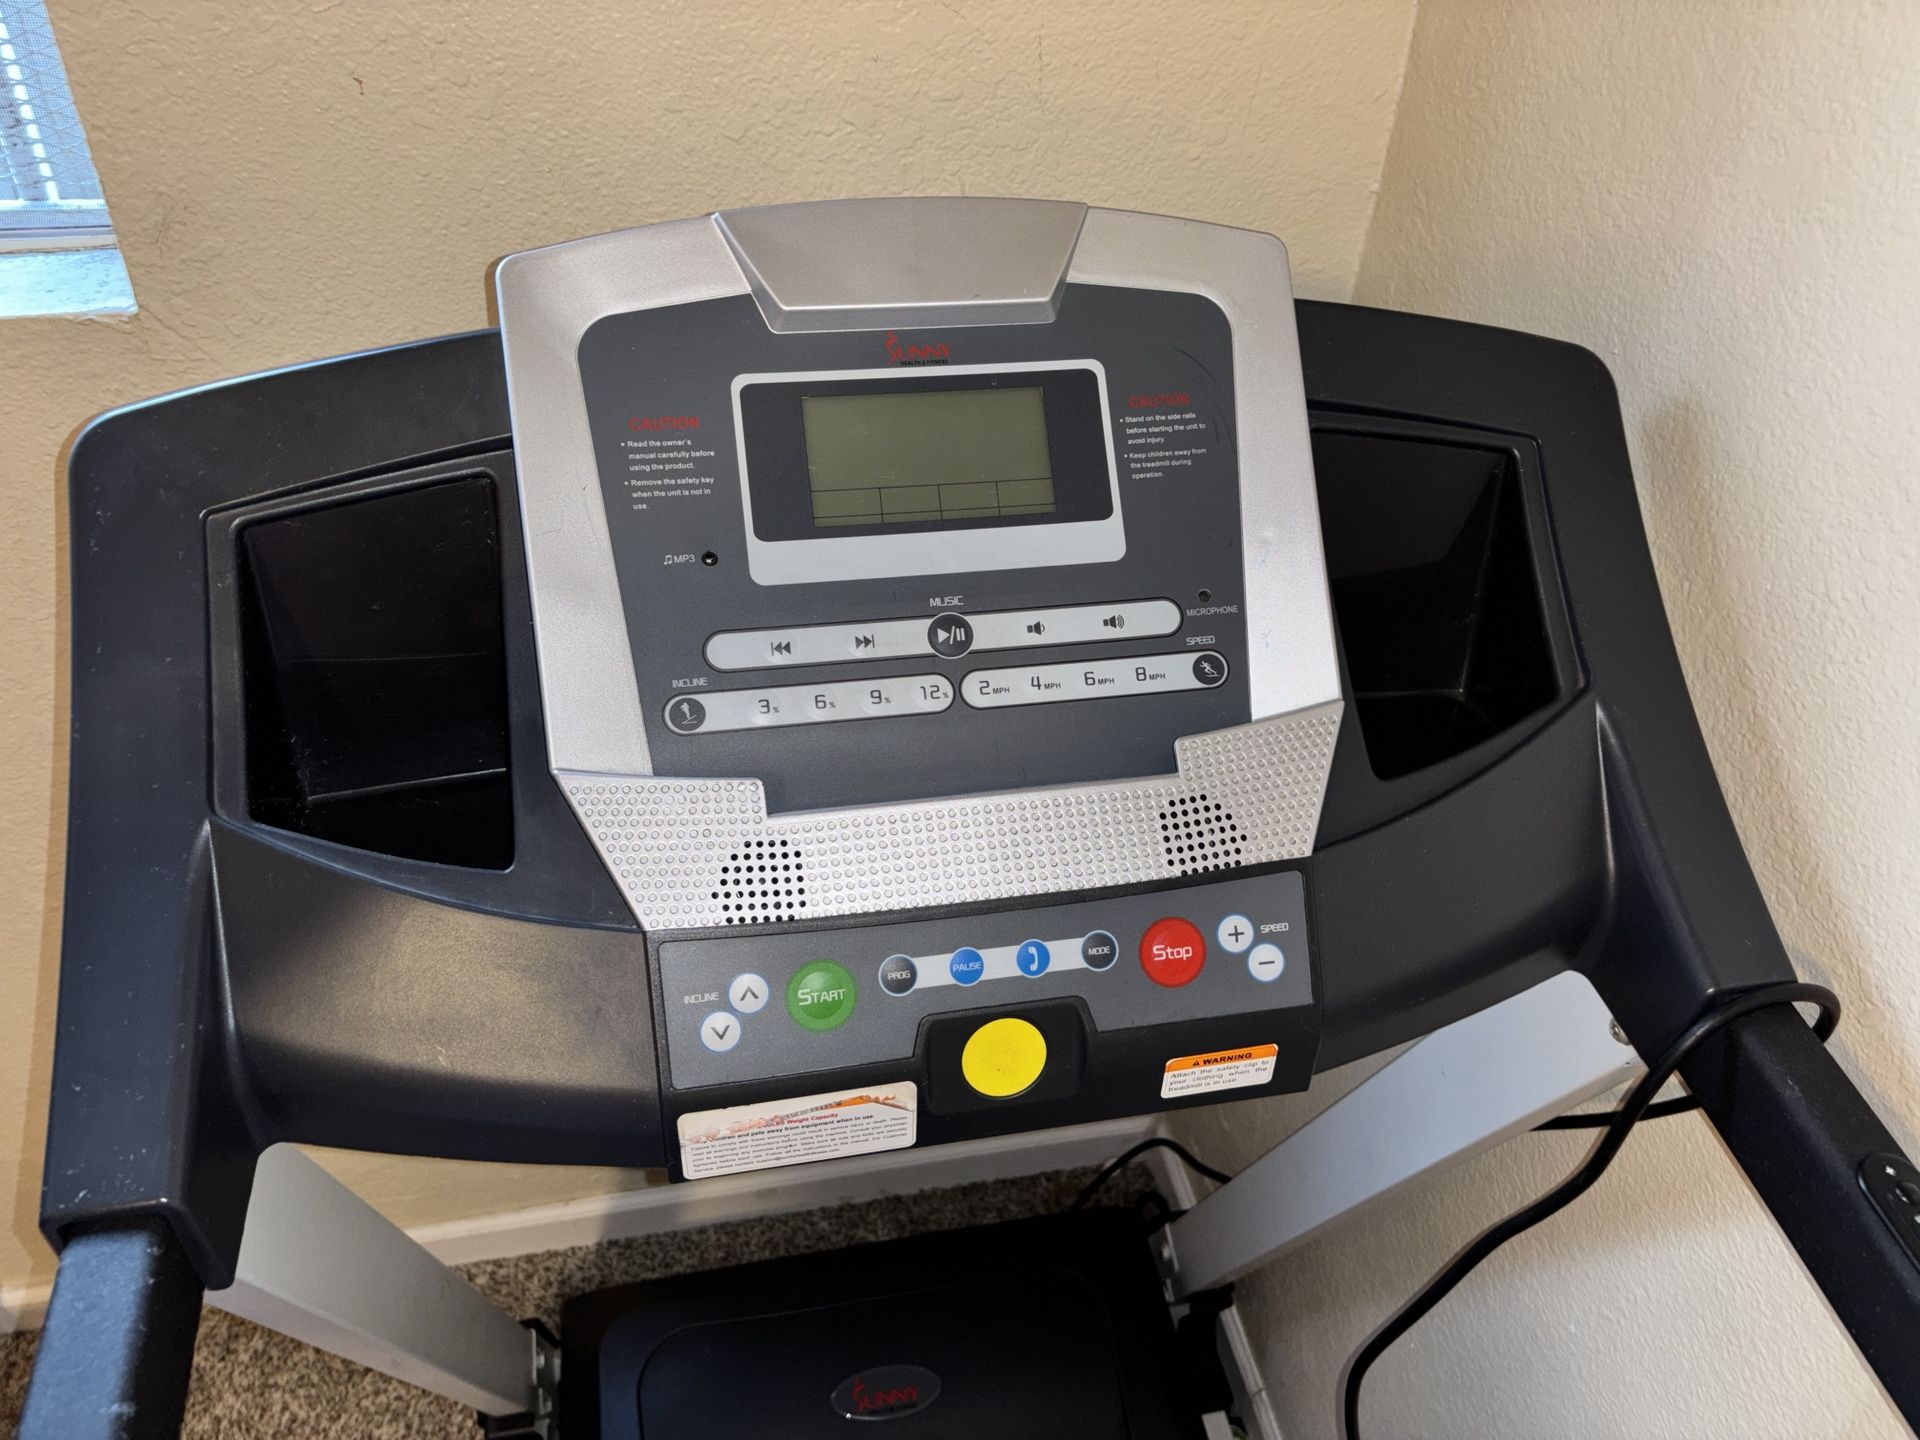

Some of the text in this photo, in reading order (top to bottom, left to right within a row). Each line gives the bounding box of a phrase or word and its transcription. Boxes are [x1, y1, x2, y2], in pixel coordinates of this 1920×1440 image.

[1128, 392, 1191, 409] CAUTION
[627, 416, 699, 431] CAUTION
[1148, 425, 1173, 433] starting
[627, 440, 648, 448] Read
[1127, 437, 1146, 445] avoid
[628, 452, 656, 460] manual
[657, 451, 690, 459] carefully
[1147, 450, 1174, 458] children
[1174, 449, 1191, 457] away
[629, 464, 650, 472] using
[665, 462, 695, 471] product.
[1142, 460, 1170, 468] treadmill
[630, 479, 662, 487] Remove
[677, 477, 700, 485] safety
[701, 476, 715, 484] key
[673, 554, 696, 564] MP3
[929, 596, 964, 608] MUSIC
[1186, 605, 1240, 617] MICROPHONE
[1185, 635, 1216, 646] SPEED
[672, 677, 708, 689] INCLINE
[979, 666, 1166, 695] 2 MPH 4 MPH 6 MPH 8 MPH
[1259, 922, 1289, 934] SPEED
[1088, 945, 1111, 956] MODE
[1153, 945, 1193, 961] Stop
[952, 961, 982, 972] PAUSE
[887, 970, 912, 981] PROG
[683, 991, 720, 1005] INCLINE
[797, 988, 846, 1006] START
[1202, 1052, 1253, 1065] WARNING
[1170, 1071, 1196, 1079] Attach
[1217, 1064, 1240, 1072] safety
[810, 1113, 839, 1121] Capacity
[801, 1120, 835, 1129] equipment
